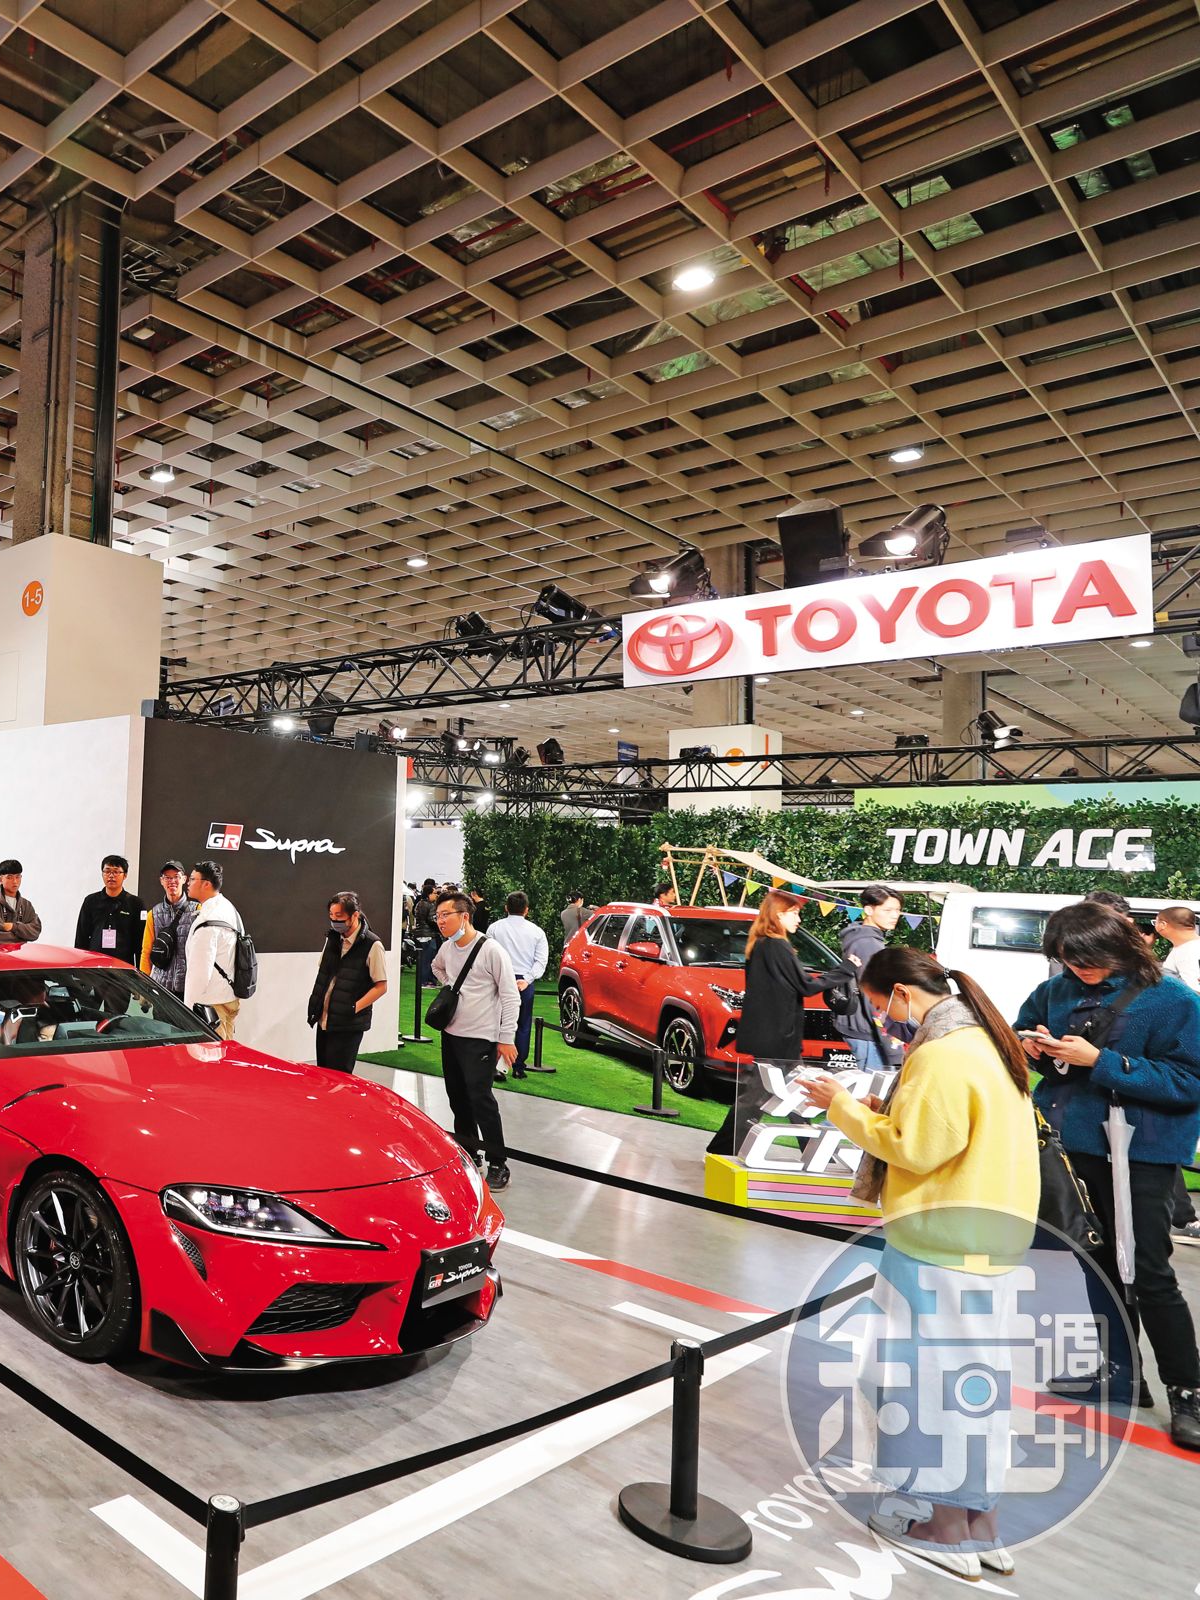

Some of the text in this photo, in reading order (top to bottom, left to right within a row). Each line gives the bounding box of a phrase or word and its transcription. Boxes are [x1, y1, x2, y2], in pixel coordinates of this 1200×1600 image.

[24, 588, 42, 607] 1-5
[745, 560, 1137, 657] TOYOTA
[208, 828, 346, 864] GR Supra
[886, 828, 1153, 870] TOWN ACE
[443, 1265, 485, 1285] Supra
